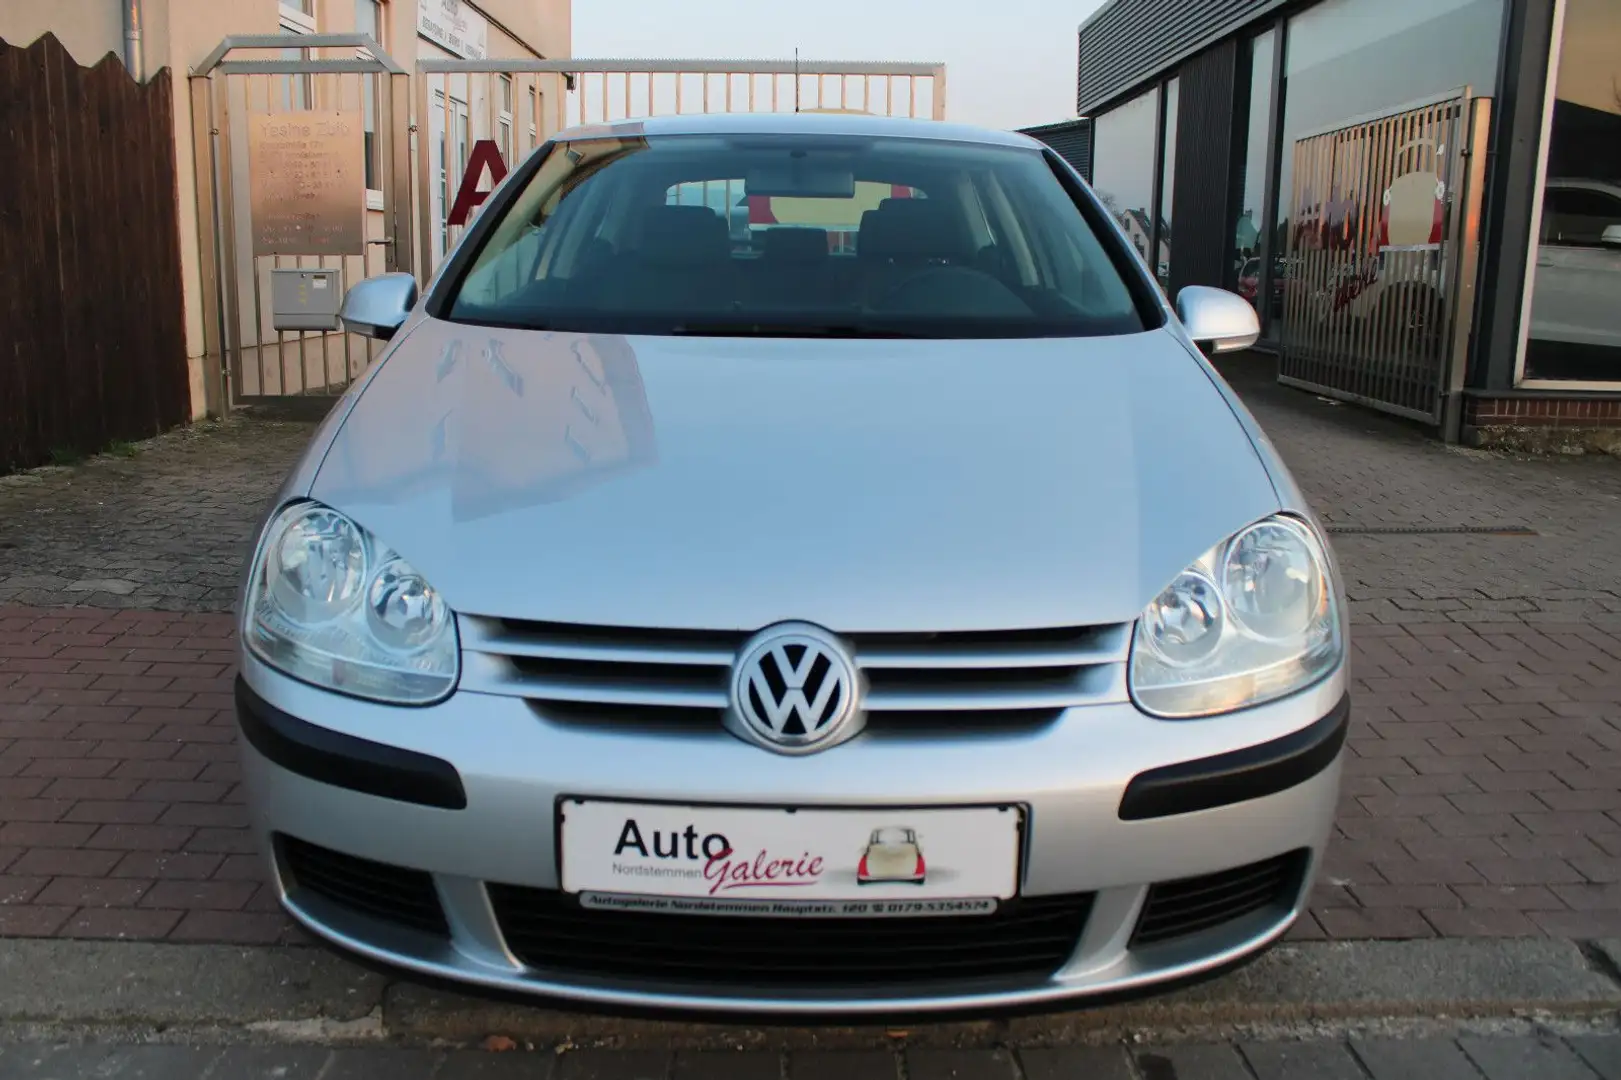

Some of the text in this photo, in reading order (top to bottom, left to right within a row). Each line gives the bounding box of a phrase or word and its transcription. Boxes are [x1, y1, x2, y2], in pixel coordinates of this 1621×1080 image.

[447, 140, 508, 227] A
[614, 818, 730, 861] Auto
[612, 861, 703, 879] Nordstemmen
[703, 847, 824, 895] Galerie
